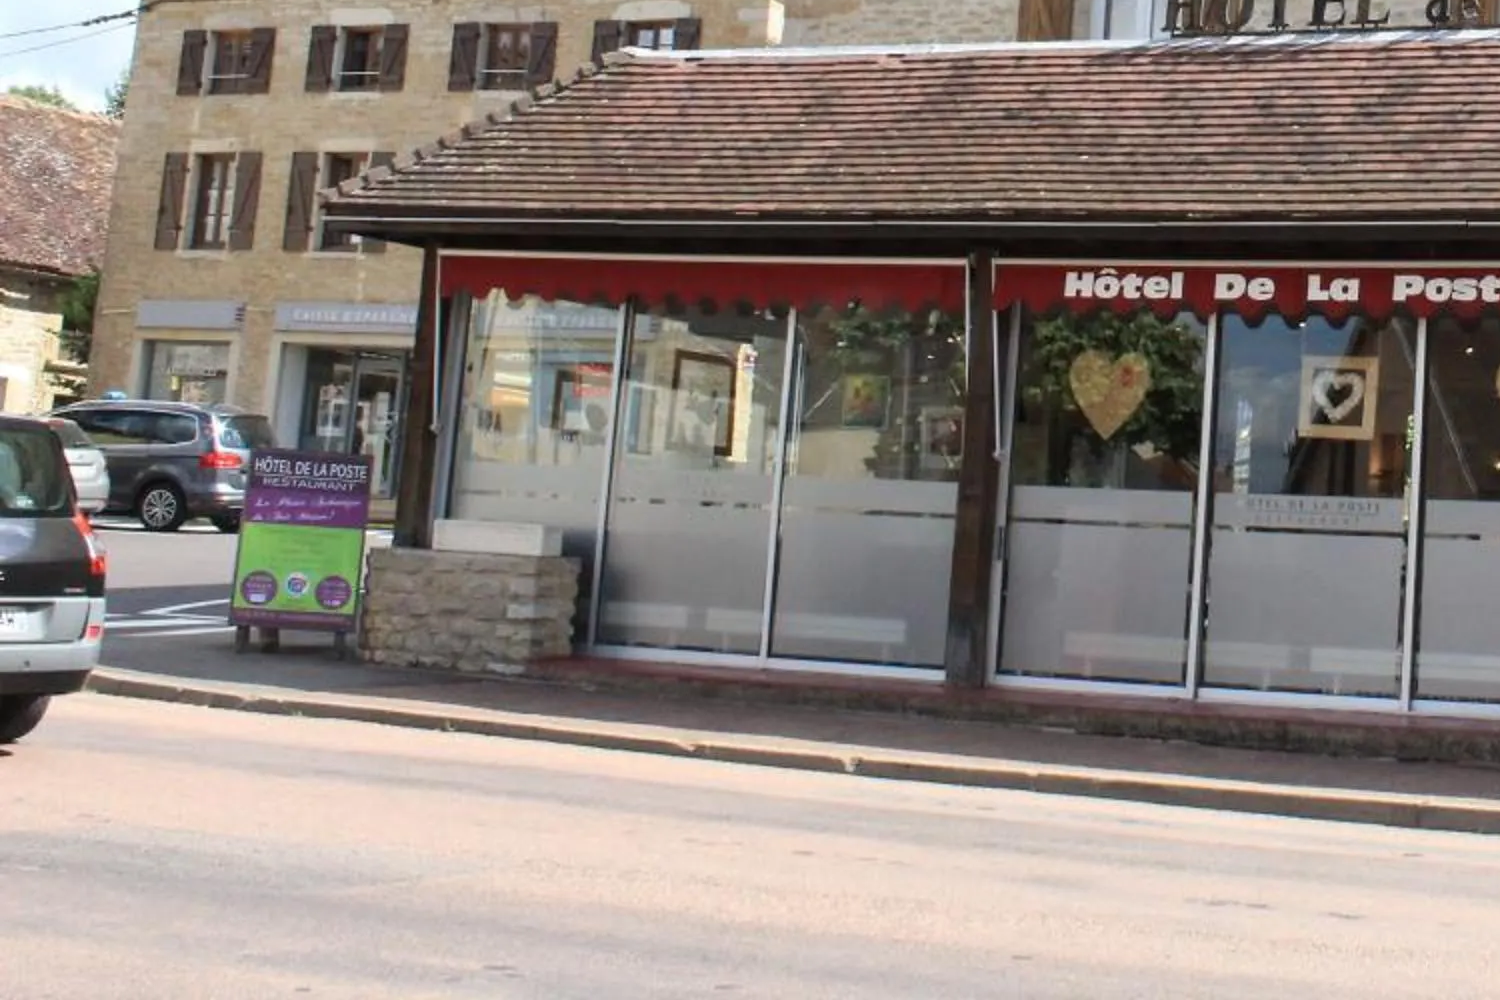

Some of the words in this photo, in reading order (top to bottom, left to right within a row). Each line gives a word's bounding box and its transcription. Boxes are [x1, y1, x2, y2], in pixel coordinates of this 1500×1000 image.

[1063, 267, 1185, 300] Hôtel
[1213, 273, 1276, 301] De
[1307, 274, 1361, 302] La
[254, 456, 293, 475] HÔTEL
[295, 460, 311, 475] DE
[313, 463, 328, 477] LA
[329, 463, 369, 479] POSTE
